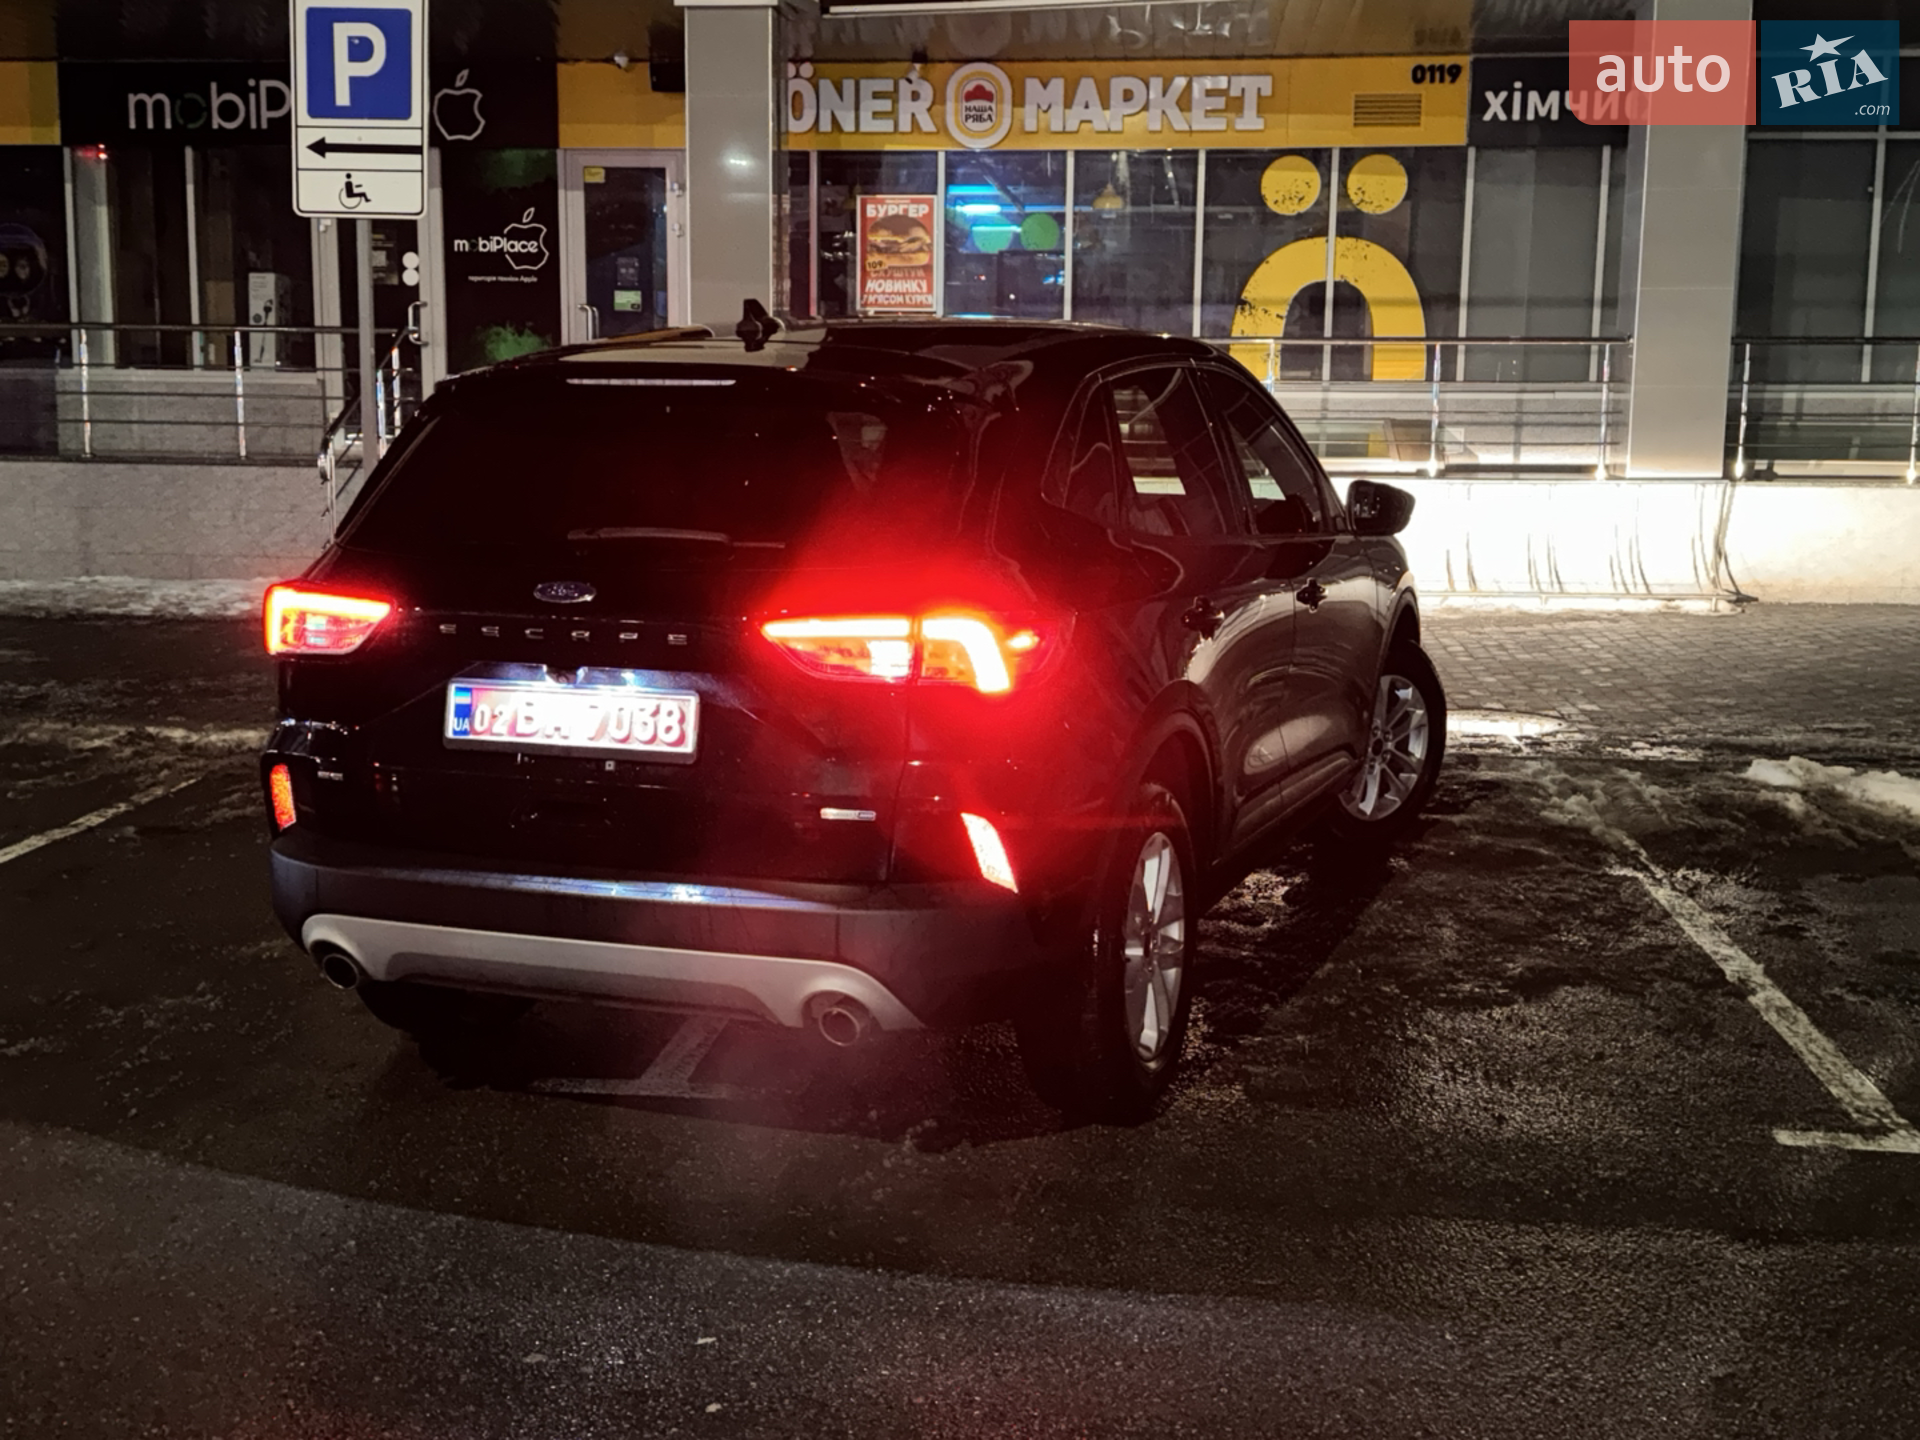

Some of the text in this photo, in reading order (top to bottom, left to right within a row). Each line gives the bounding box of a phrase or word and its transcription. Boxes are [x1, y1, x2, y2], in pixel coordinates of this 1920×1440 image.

[333, 22, 387, 106] P
[1411, 64, 1463, 84] 0119
[1024, 75, 1273, 132] МАРКЕТ
[965, 114, 993, 123] РЯБА
[866, 204, 930, 218] БУРГЕР
[453, 235, 539, 253] mobiPlace
[865, 279, 928, 293] НОВИНКУ
[439, 624, 688, 645] ESCAPE
[453, 717, 470, 732] UA
